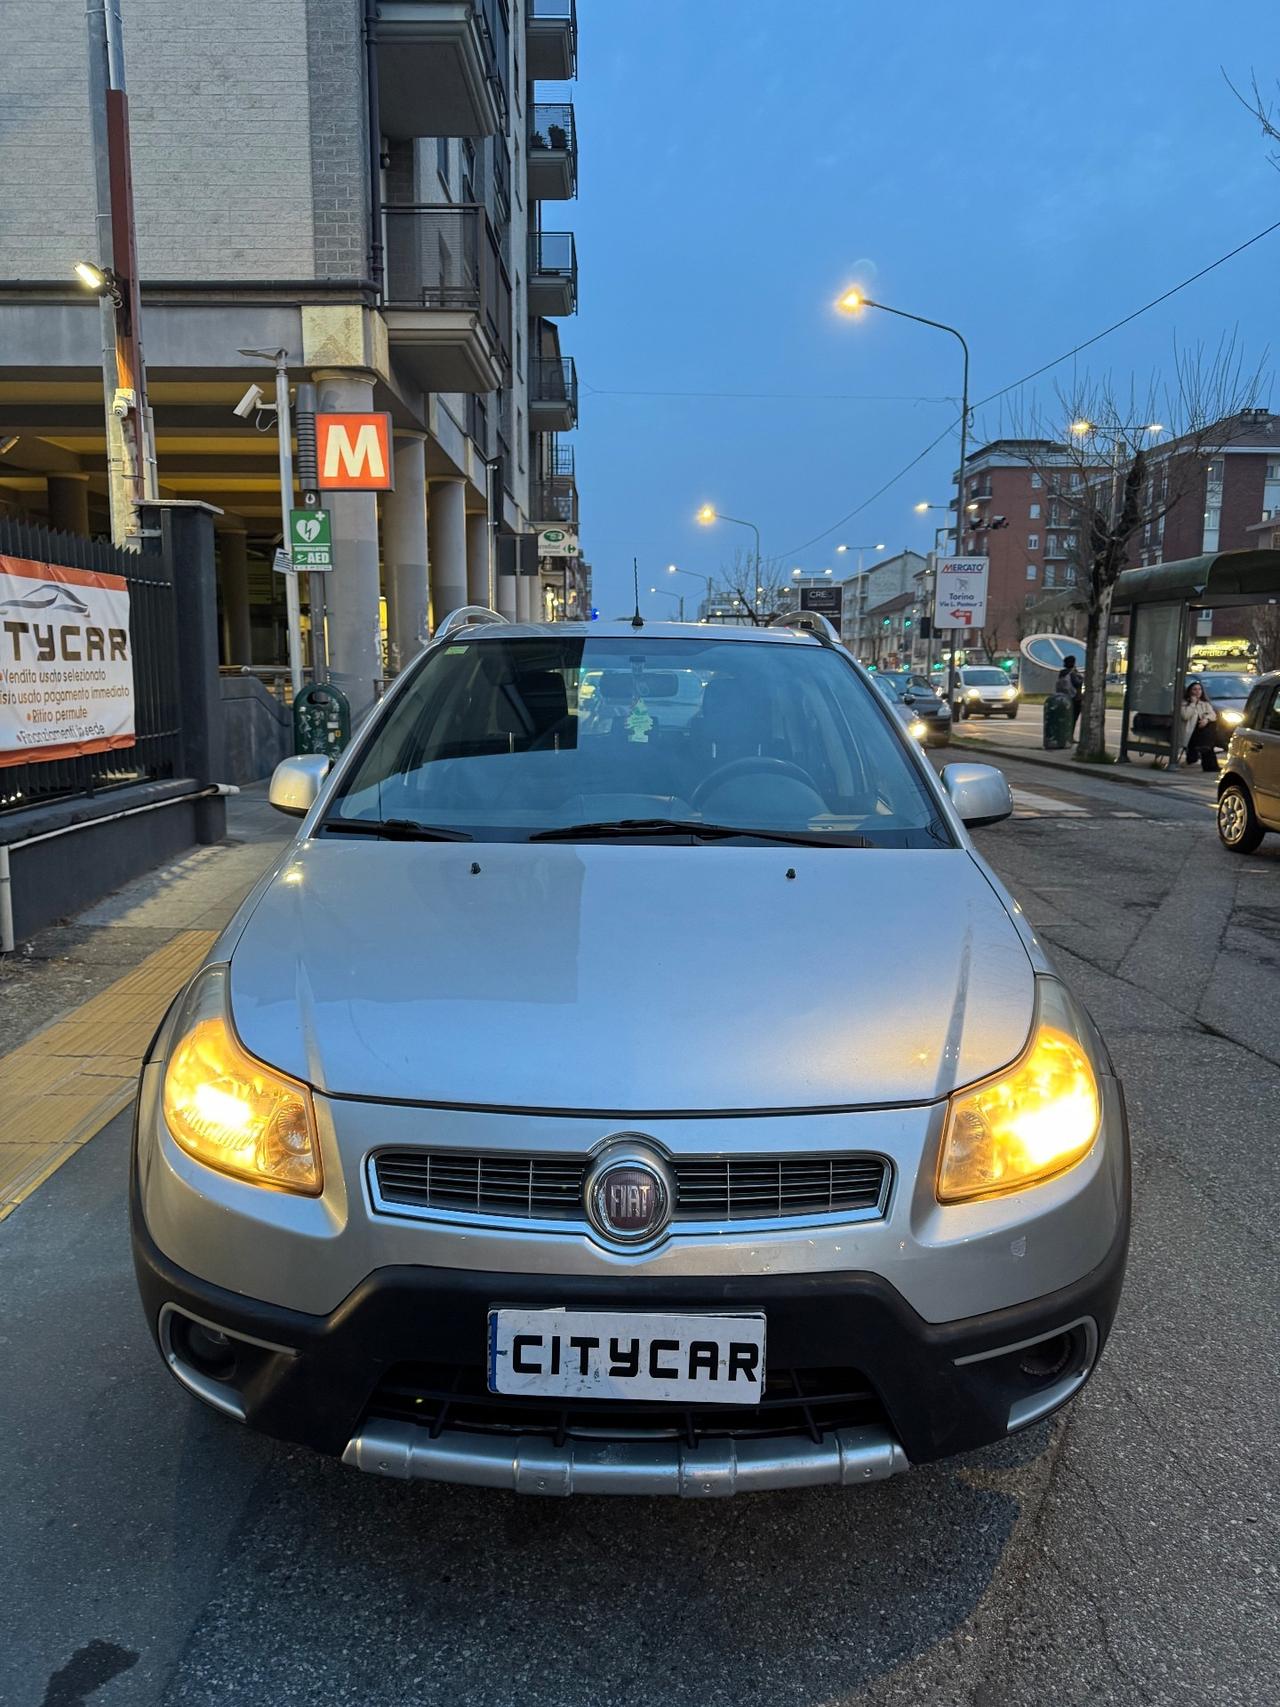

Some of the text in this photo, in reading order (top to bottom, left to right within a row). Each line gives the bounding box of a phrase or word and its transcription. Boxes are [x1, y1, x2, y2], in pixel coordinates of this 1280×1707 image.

[324, 424, 385, 477] M
[307, 552, 330, 564] AED
[950, 592, 974, 600] Torino
[3, 621, 128, 662] TYCAR
[3, 668, 106, 684] Vendita usato selezionato
[18, 689, 42, 704] usato
[44, 688, 89, 705] pagamento
[91, 685, 130, 699] immediato
[32, 706, 88, 724] Ritiro permute
[20, 727, 75, 745] Finanziamenti
[85, 722, 106, 736] sede
[610, 1184, 651, 1219] FIAT
[512, 1334, 760, 1382] CITYCAR
